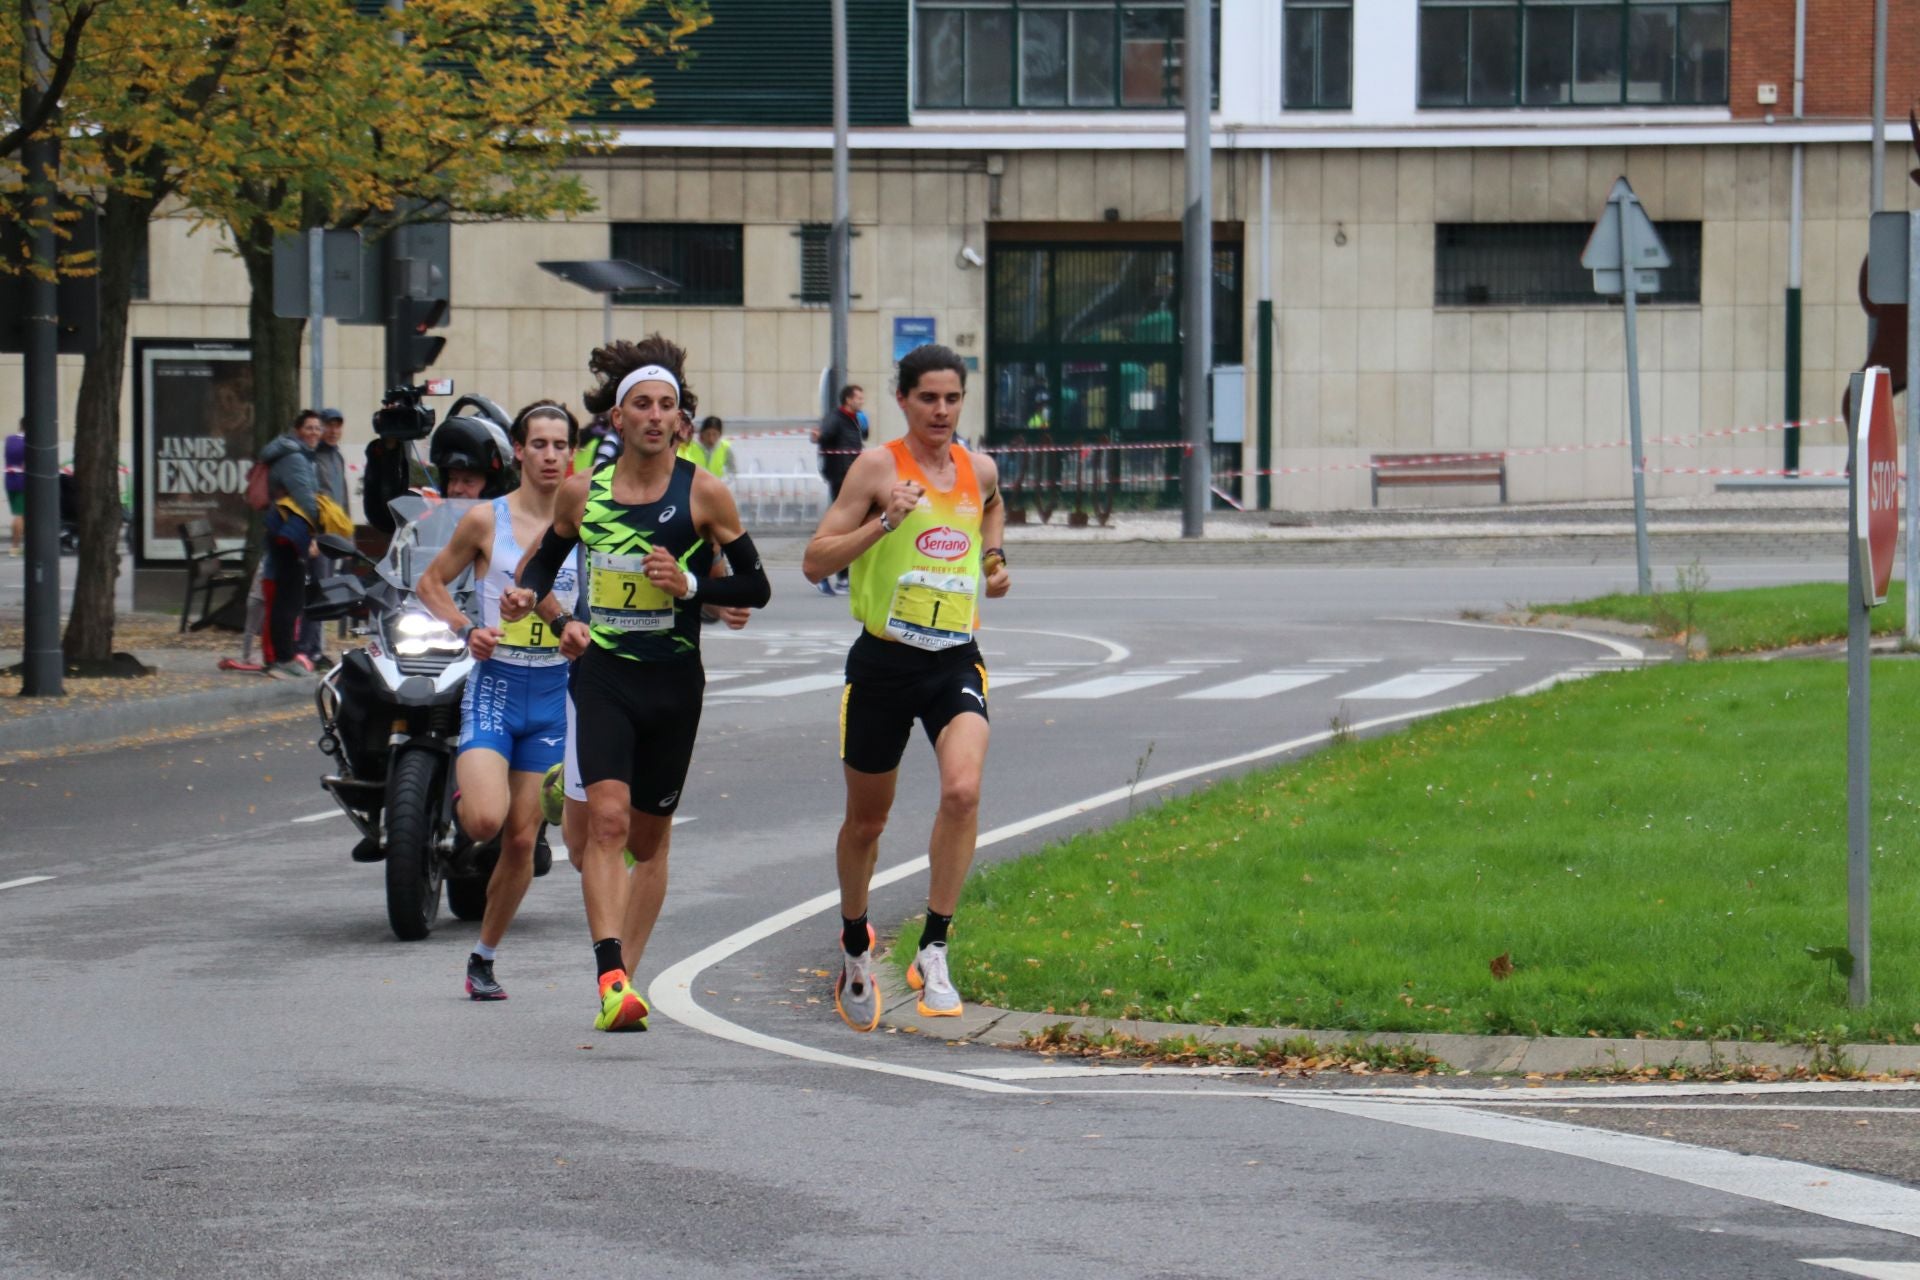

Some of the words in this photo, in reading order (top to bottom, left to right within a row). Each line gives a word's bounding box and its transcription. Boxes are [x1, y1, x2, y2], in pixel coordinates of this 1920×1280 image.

[158, 437, 226, 459] JAMES
[1871, 460, 1897, 511] STOP
[922, 535, 967, 551] Serrano
[623, 582, 637, 609] 2
[619, 618, 660, 626] HYUNDAI
[930, 600, 941, 628] 1
[529, 622, 544, 647] 9
